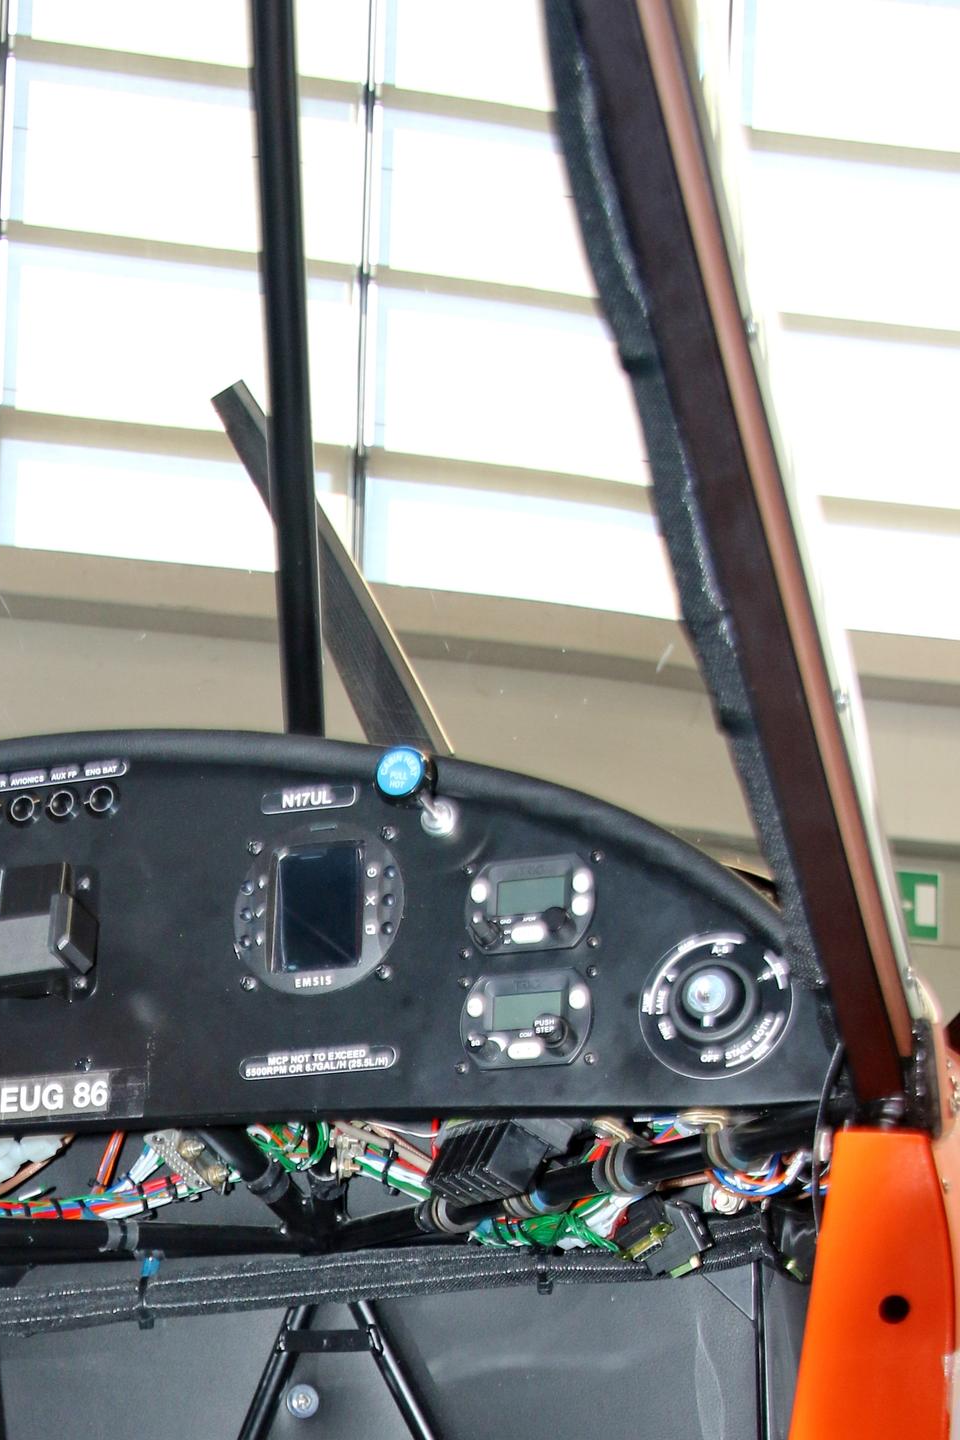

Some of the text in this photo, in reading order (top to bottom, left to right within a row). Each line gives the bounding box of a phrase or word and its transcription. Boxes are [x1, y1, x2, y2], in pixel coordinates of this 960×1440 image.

[103, 766, 117, 774] BAT
[10, 775, 45, 786] AVIONICS
[51, 771, 77, 781] AUX FP
[282, 791, 332, 808] N17UL
[295, 975, 332, 988] EMSIS
[534, 1019, 554, 1027] PUSH
[536, 1026, 554, 1034] STEP
[268, 1049, 366, 1066] MCP NOT TO EXCEED
[700, 1055, 720, 1063] OFF
[245, 1066, 287, 1077] 5500RPM
[288, 1064, 303, 1074] OR
[0, 1083, 63, 1113] EUG
[72, 1080, 108, 1108] 86
